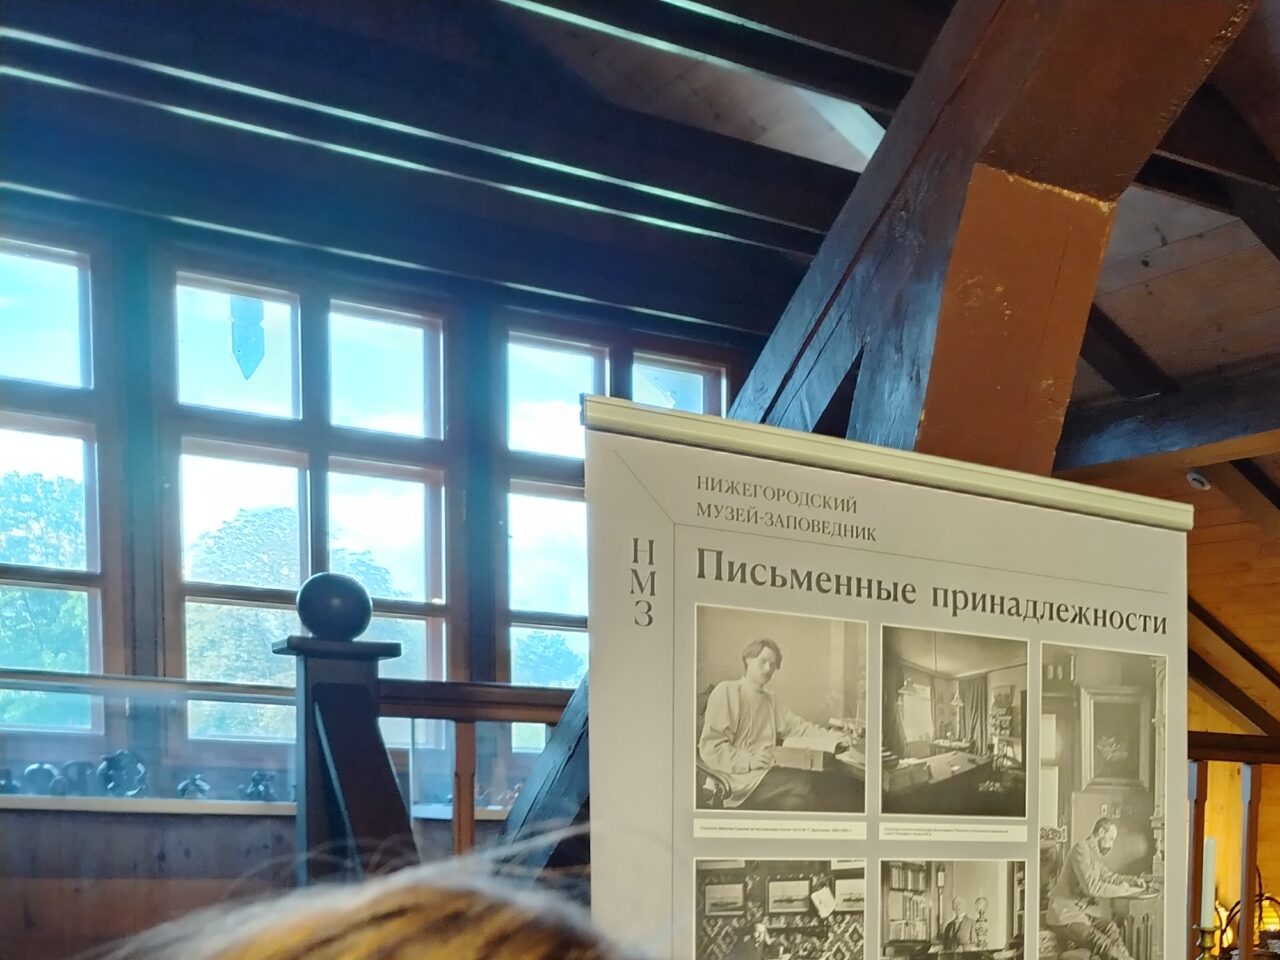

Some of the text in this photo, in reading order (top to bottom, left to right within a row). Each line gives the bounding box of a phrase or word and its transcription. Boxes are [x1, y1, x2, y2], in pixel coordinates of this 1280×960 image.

[696, 474, 858, 515] НИЖЕГОРОДСКИЙ
[696, 502, 877, 543] МУЗЕЙ-ЗАПОВЕДНИК
[695, 547, 1169, 637] Письменные принадлежности
